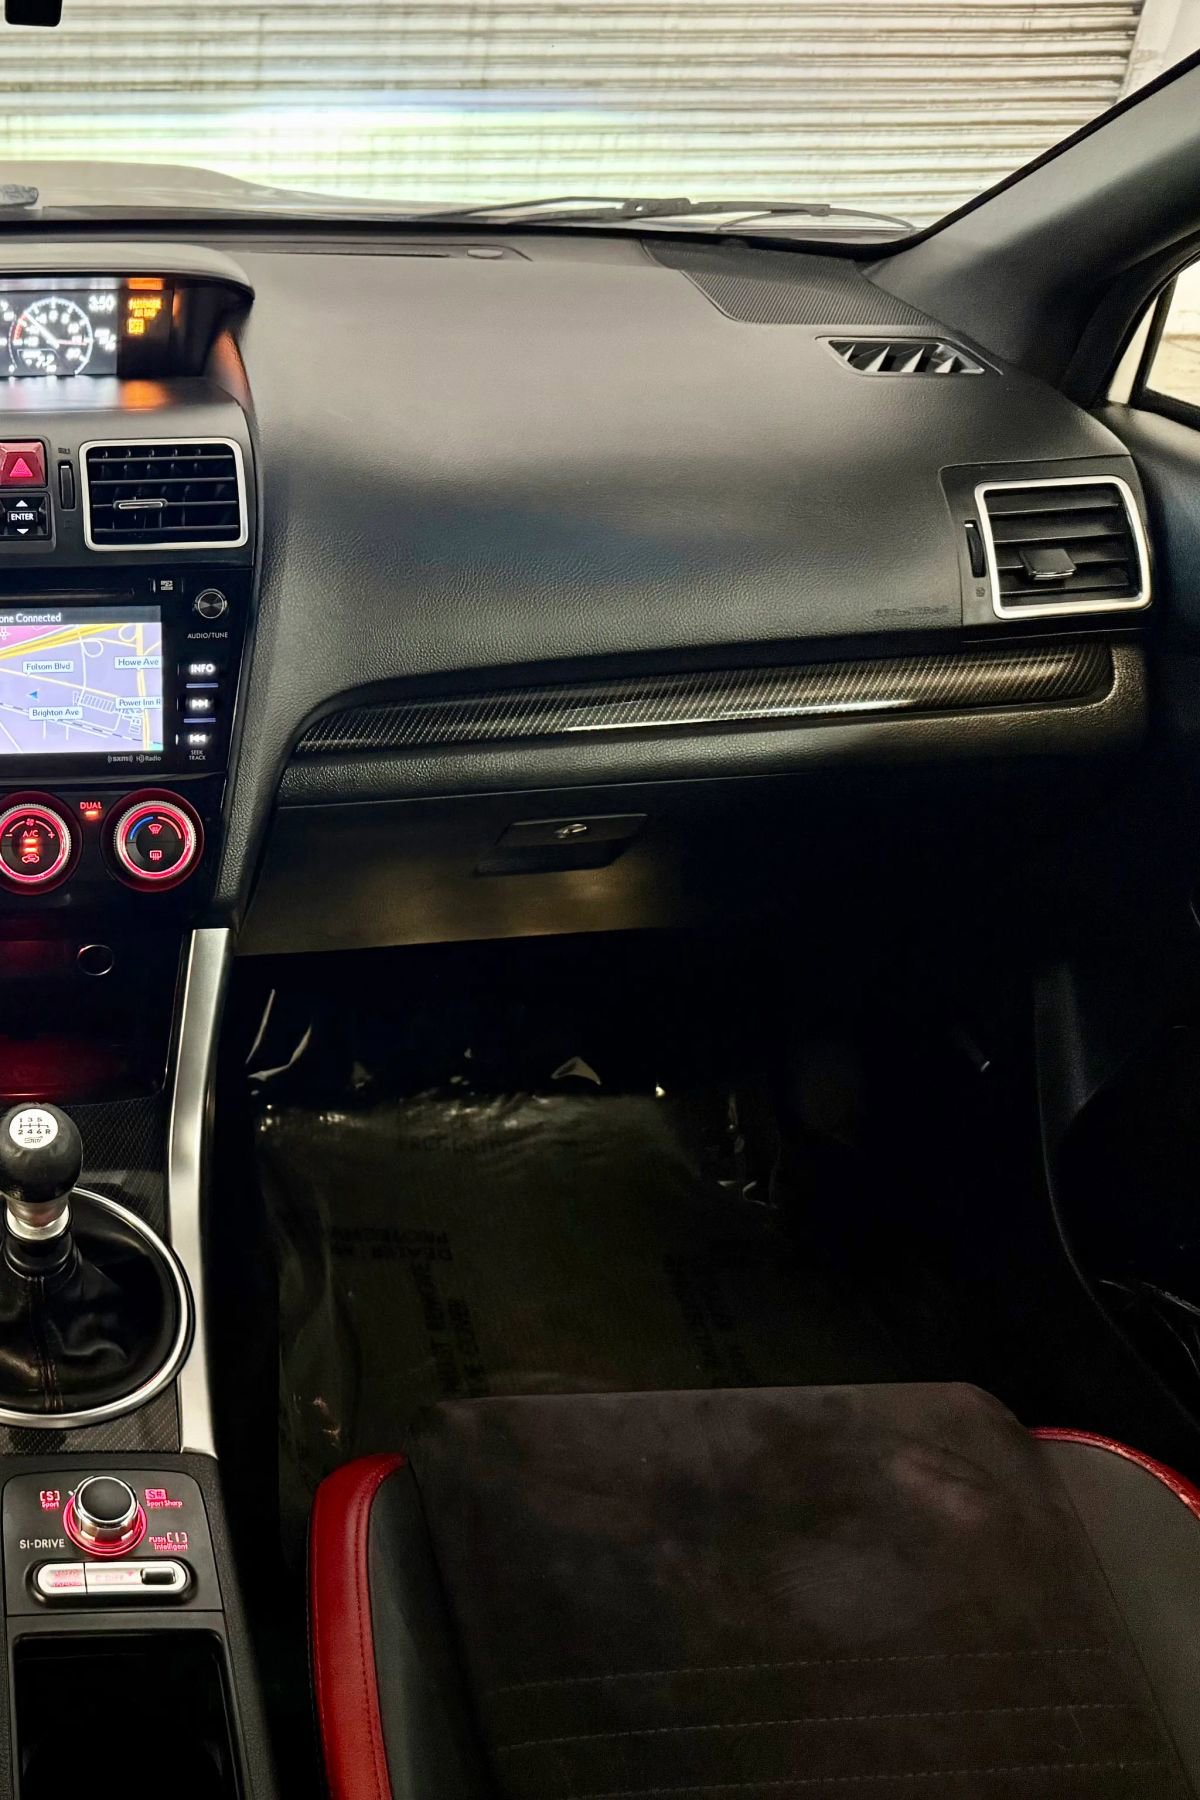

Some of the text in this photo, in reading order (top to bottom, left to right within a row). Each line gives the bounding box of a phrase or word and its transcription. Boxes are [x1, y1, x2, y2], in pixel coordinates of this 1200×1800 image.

[10, 513, 34, 521] ENTER
[15, 612, 61, 623] Connected
[187, 631, 228, 639] AUDIO/TUNE
[26, 662, 71, 671] Folsom Blvd
[118, 658, 159, 666] Howe Ave
[189, 663, 215, 674] INFO
[119, 699, 140, 707] Power
[32, 708, 79, 718] Brighton Ave
[79, 801, 102, 810] DUAL
[22, 829, 39, 838] A/C
[41, 1501, 59, 1510] Sport
[147, 1500, 183, 1508] Sport Sharp
[19, 1538, 65, 1549] SI-DRIVE
[154, 1542, 188, 1551] Intelligent
